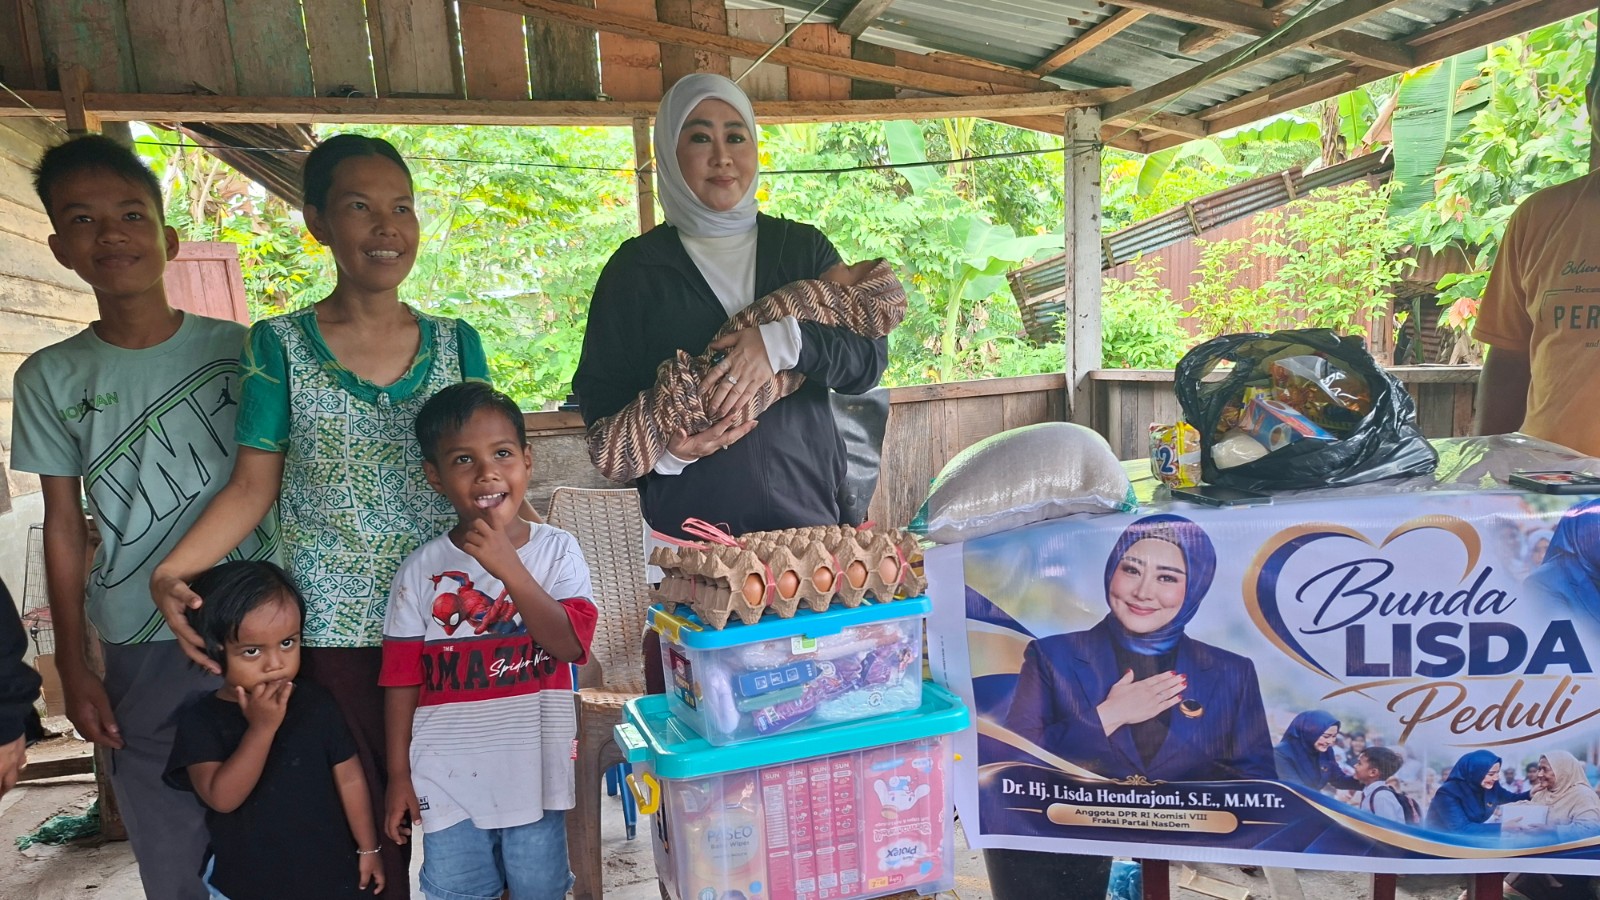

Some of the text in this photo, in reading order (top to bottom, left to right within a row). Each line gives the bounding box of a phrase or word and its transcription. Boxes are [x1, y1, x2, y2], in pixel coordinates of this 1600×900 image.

[1295, 558, 1517, 634] Bunda
[1345, 619, 1593, 678] LISDA
[1386, 676, 1600, 748] Peduli
[1002, 778, 1285, 809] Dr. Hj. Lisda Hendrajoni, S.E., M.M.Tr.
[1075, 808, 1115, 819] Anggota
[1118, 810, 1137, 818] DPR
[1153, 812, 1187, 820] Komisi
[1189, 813, 1207, 821] VIII
[1092, 817, 1190, 829] Fraksi Partai NasDem
[707, 825, 753, 842] PASEO
